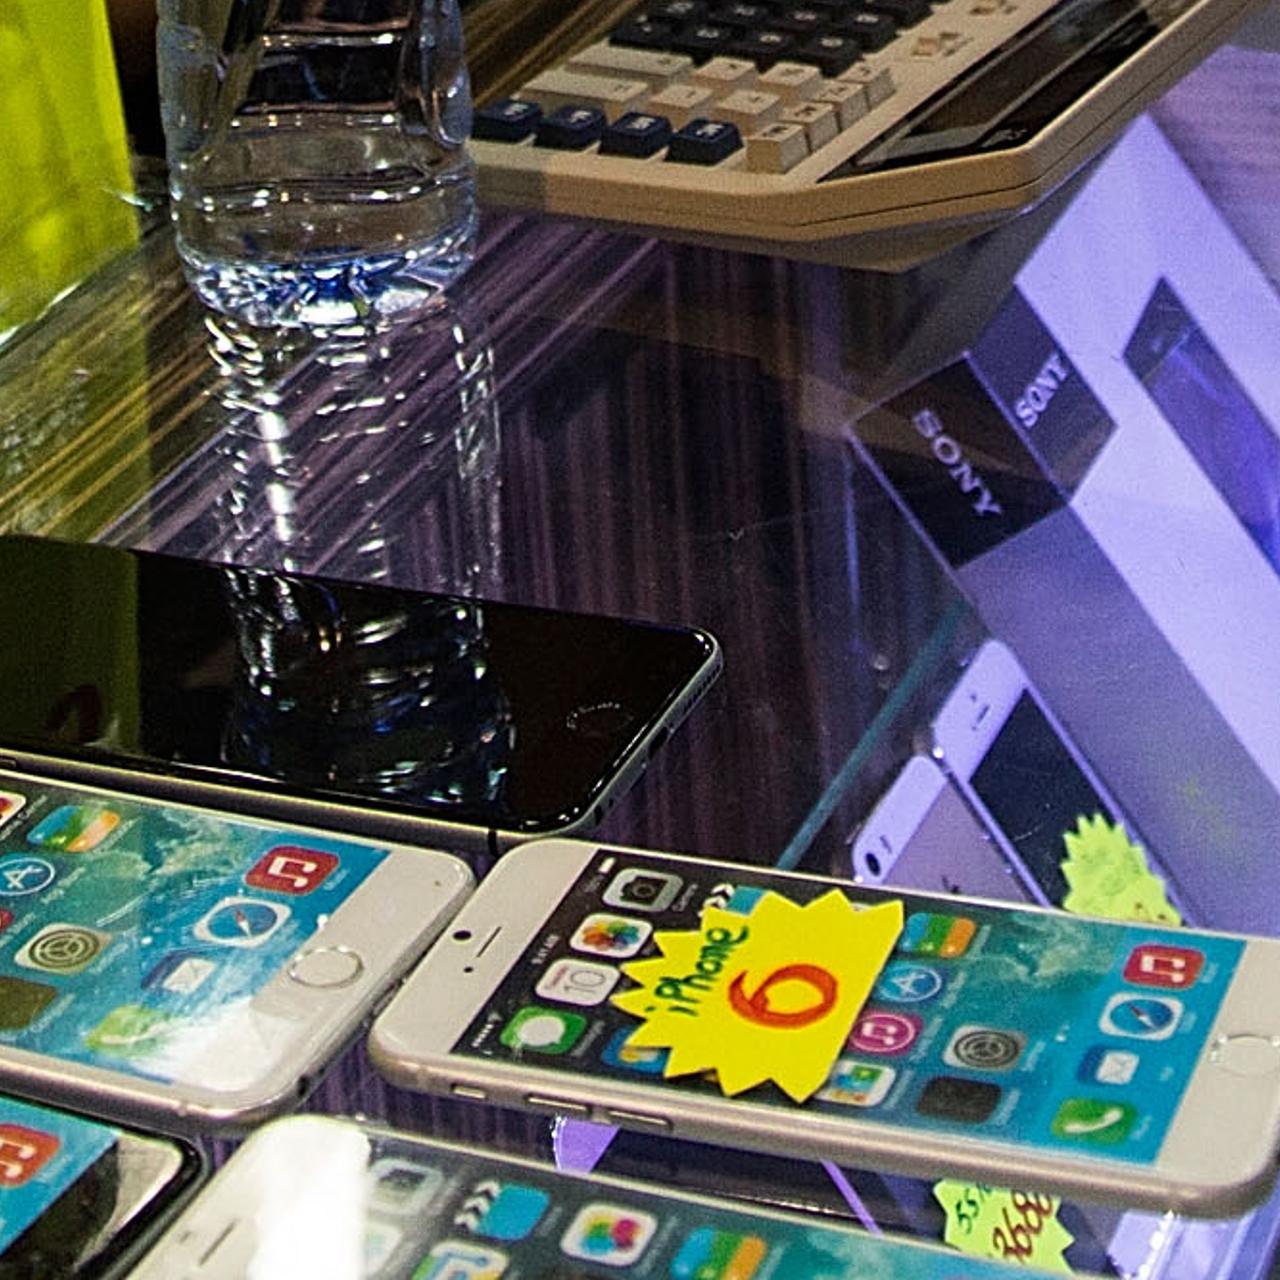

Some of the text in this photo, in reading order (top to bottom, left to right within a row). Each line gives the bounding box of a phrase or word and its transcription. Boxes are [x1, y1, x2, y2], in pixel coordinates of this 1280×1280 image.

[1015, 351, 1069, 429] SONY
[912, 407, 1003, 518] SONY
[558, 967, 610, 996] 10
[645, 926, 749, 1016] iPhone
[727, 963, 839, 1028] 6
